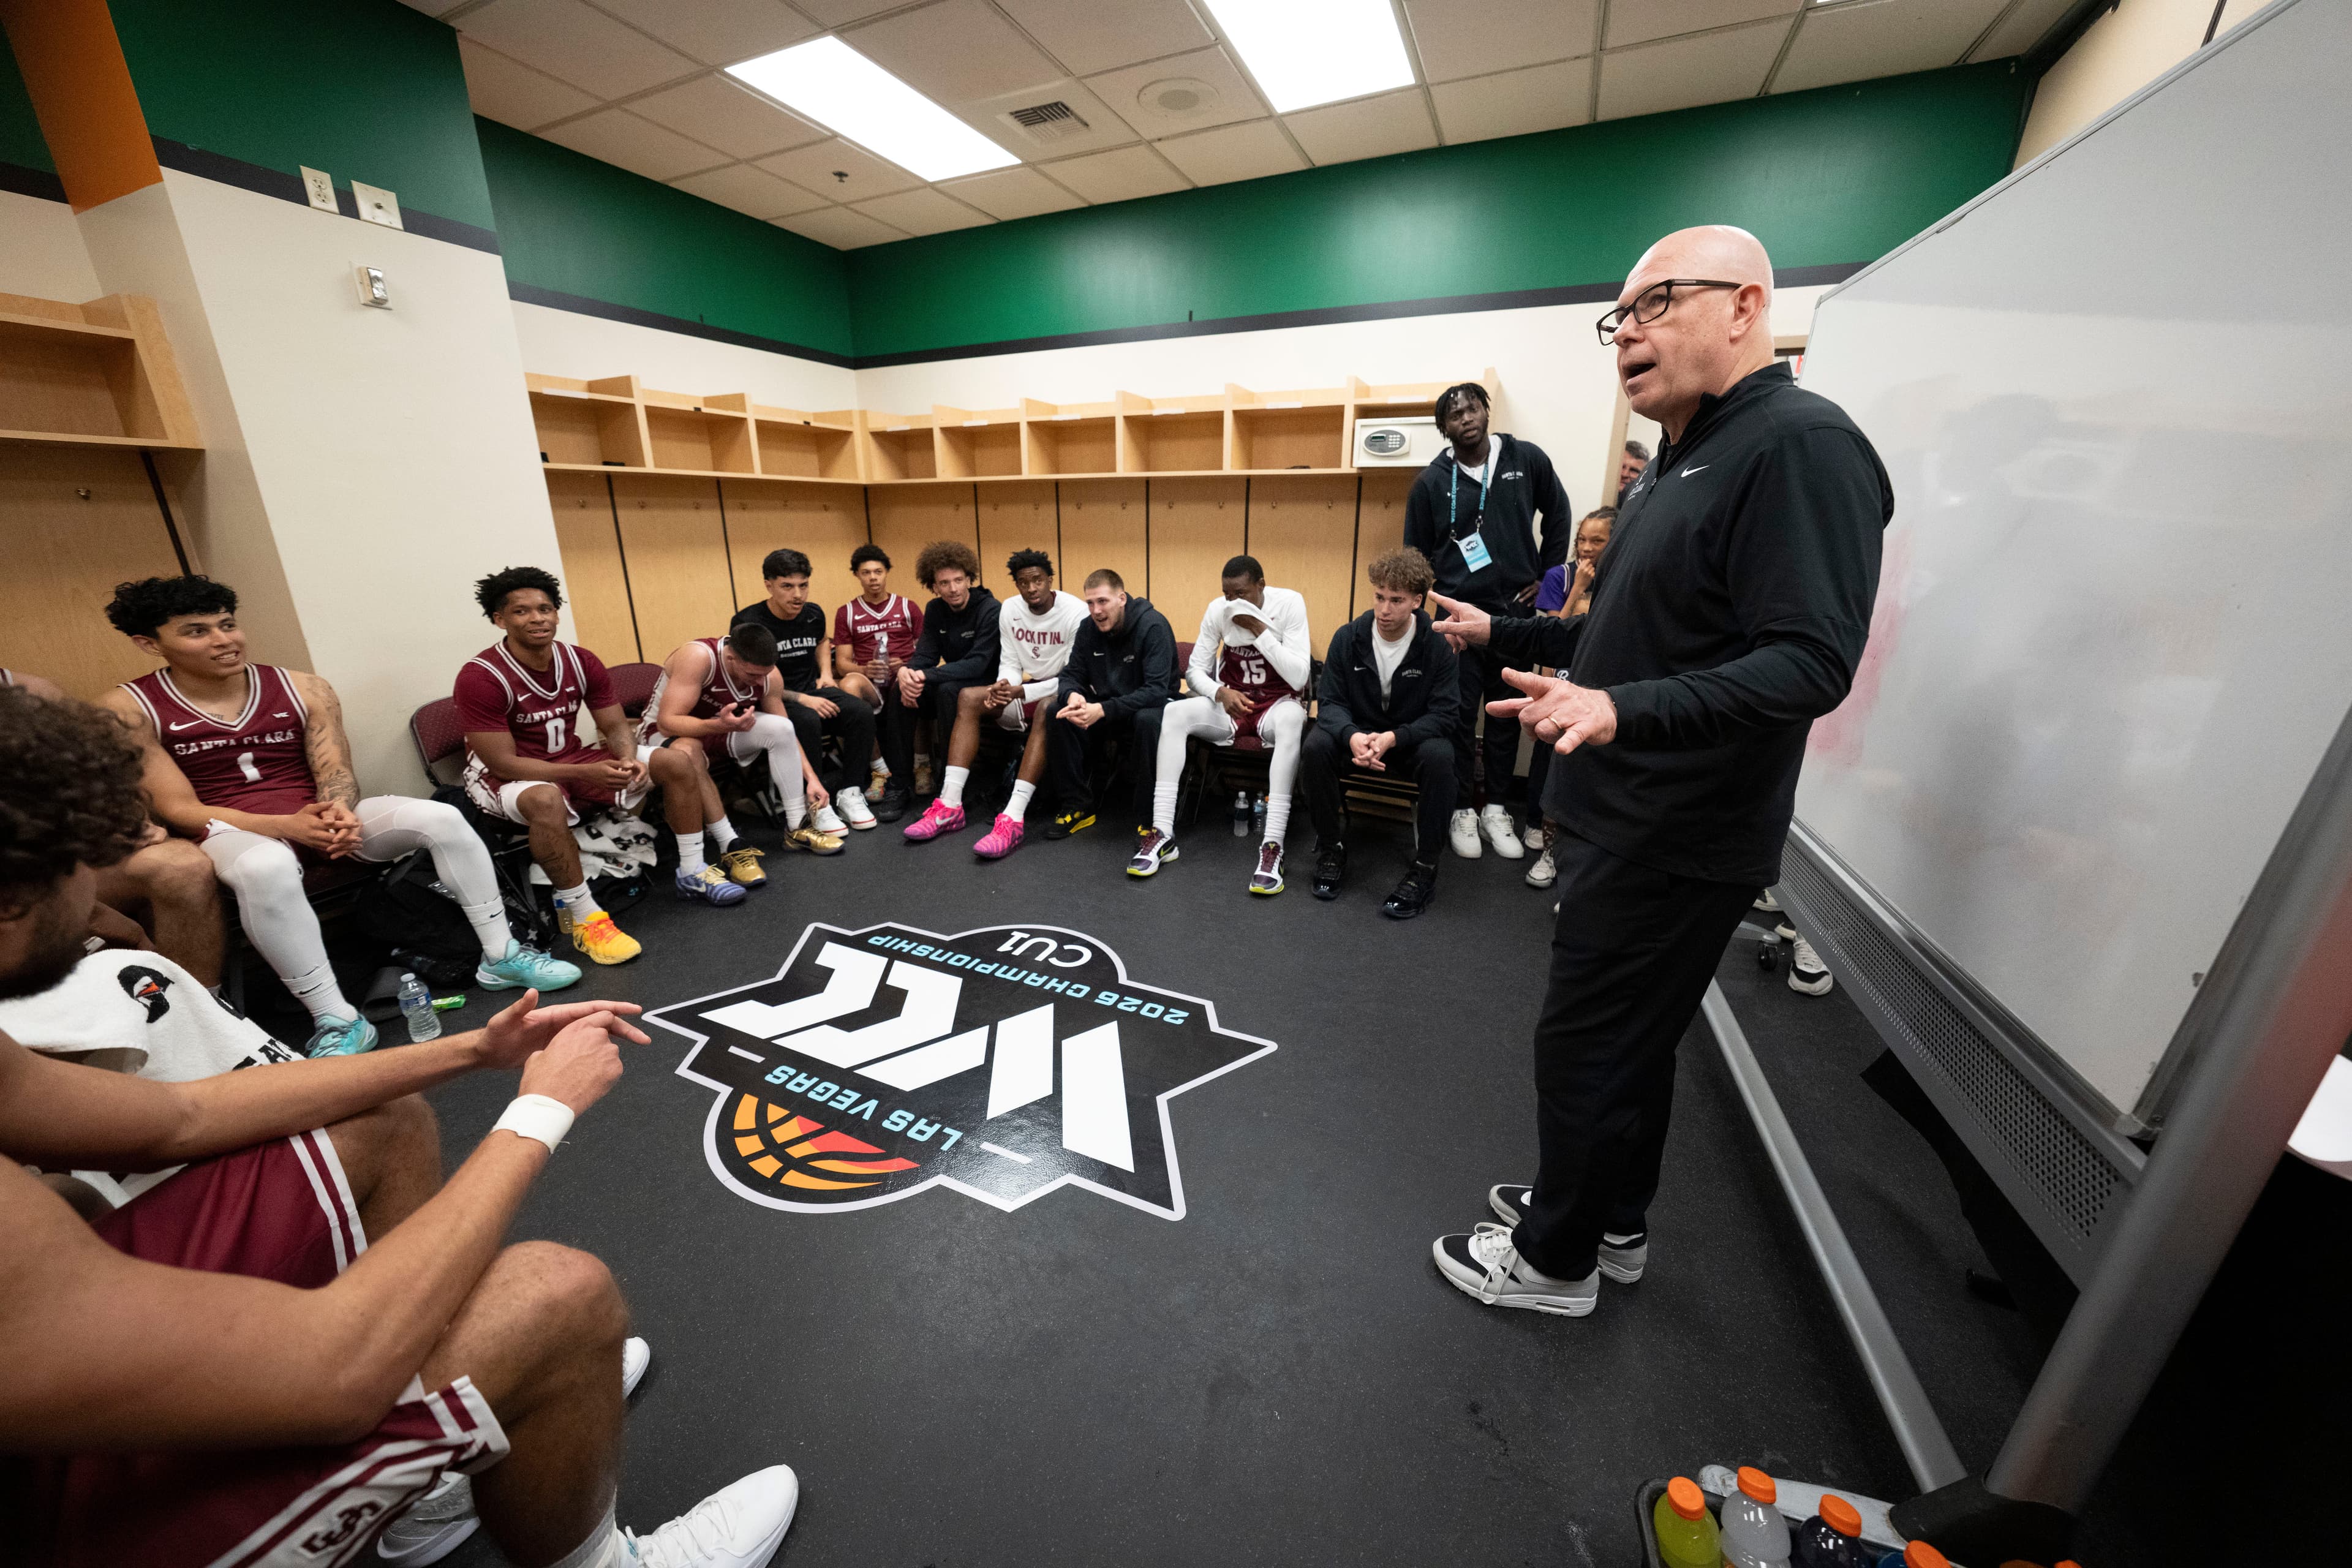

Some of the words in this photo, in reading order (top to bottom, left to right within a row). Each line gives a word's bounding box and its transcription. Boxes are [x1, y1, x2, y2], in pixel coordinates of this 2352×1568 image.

[776, 639, 792, 652] NTA
[792, 637, 817, 648] CLARA
[857, 625, 879, 633] SANTA
[1038, 631, 1048, 644] IT
[1049, 631, 1065, 645] IN.
[1240, 658, 1267, 685] 15
[516, 710, 554, 724] SANTA
[174, 739, 237, 755] SANTA
[545, 717, 566, 753] 0
[237, 752, 263, 783] 1
[997, 930, 1092, 968] CU1
[867, 935, 1090, 998] CHAMPIONSHIP
[1095, 990, 1189, 1025] 2026
[764, 1065, 880, 1121] VEGAS
[881, 1109, 963, 1152] LAS
